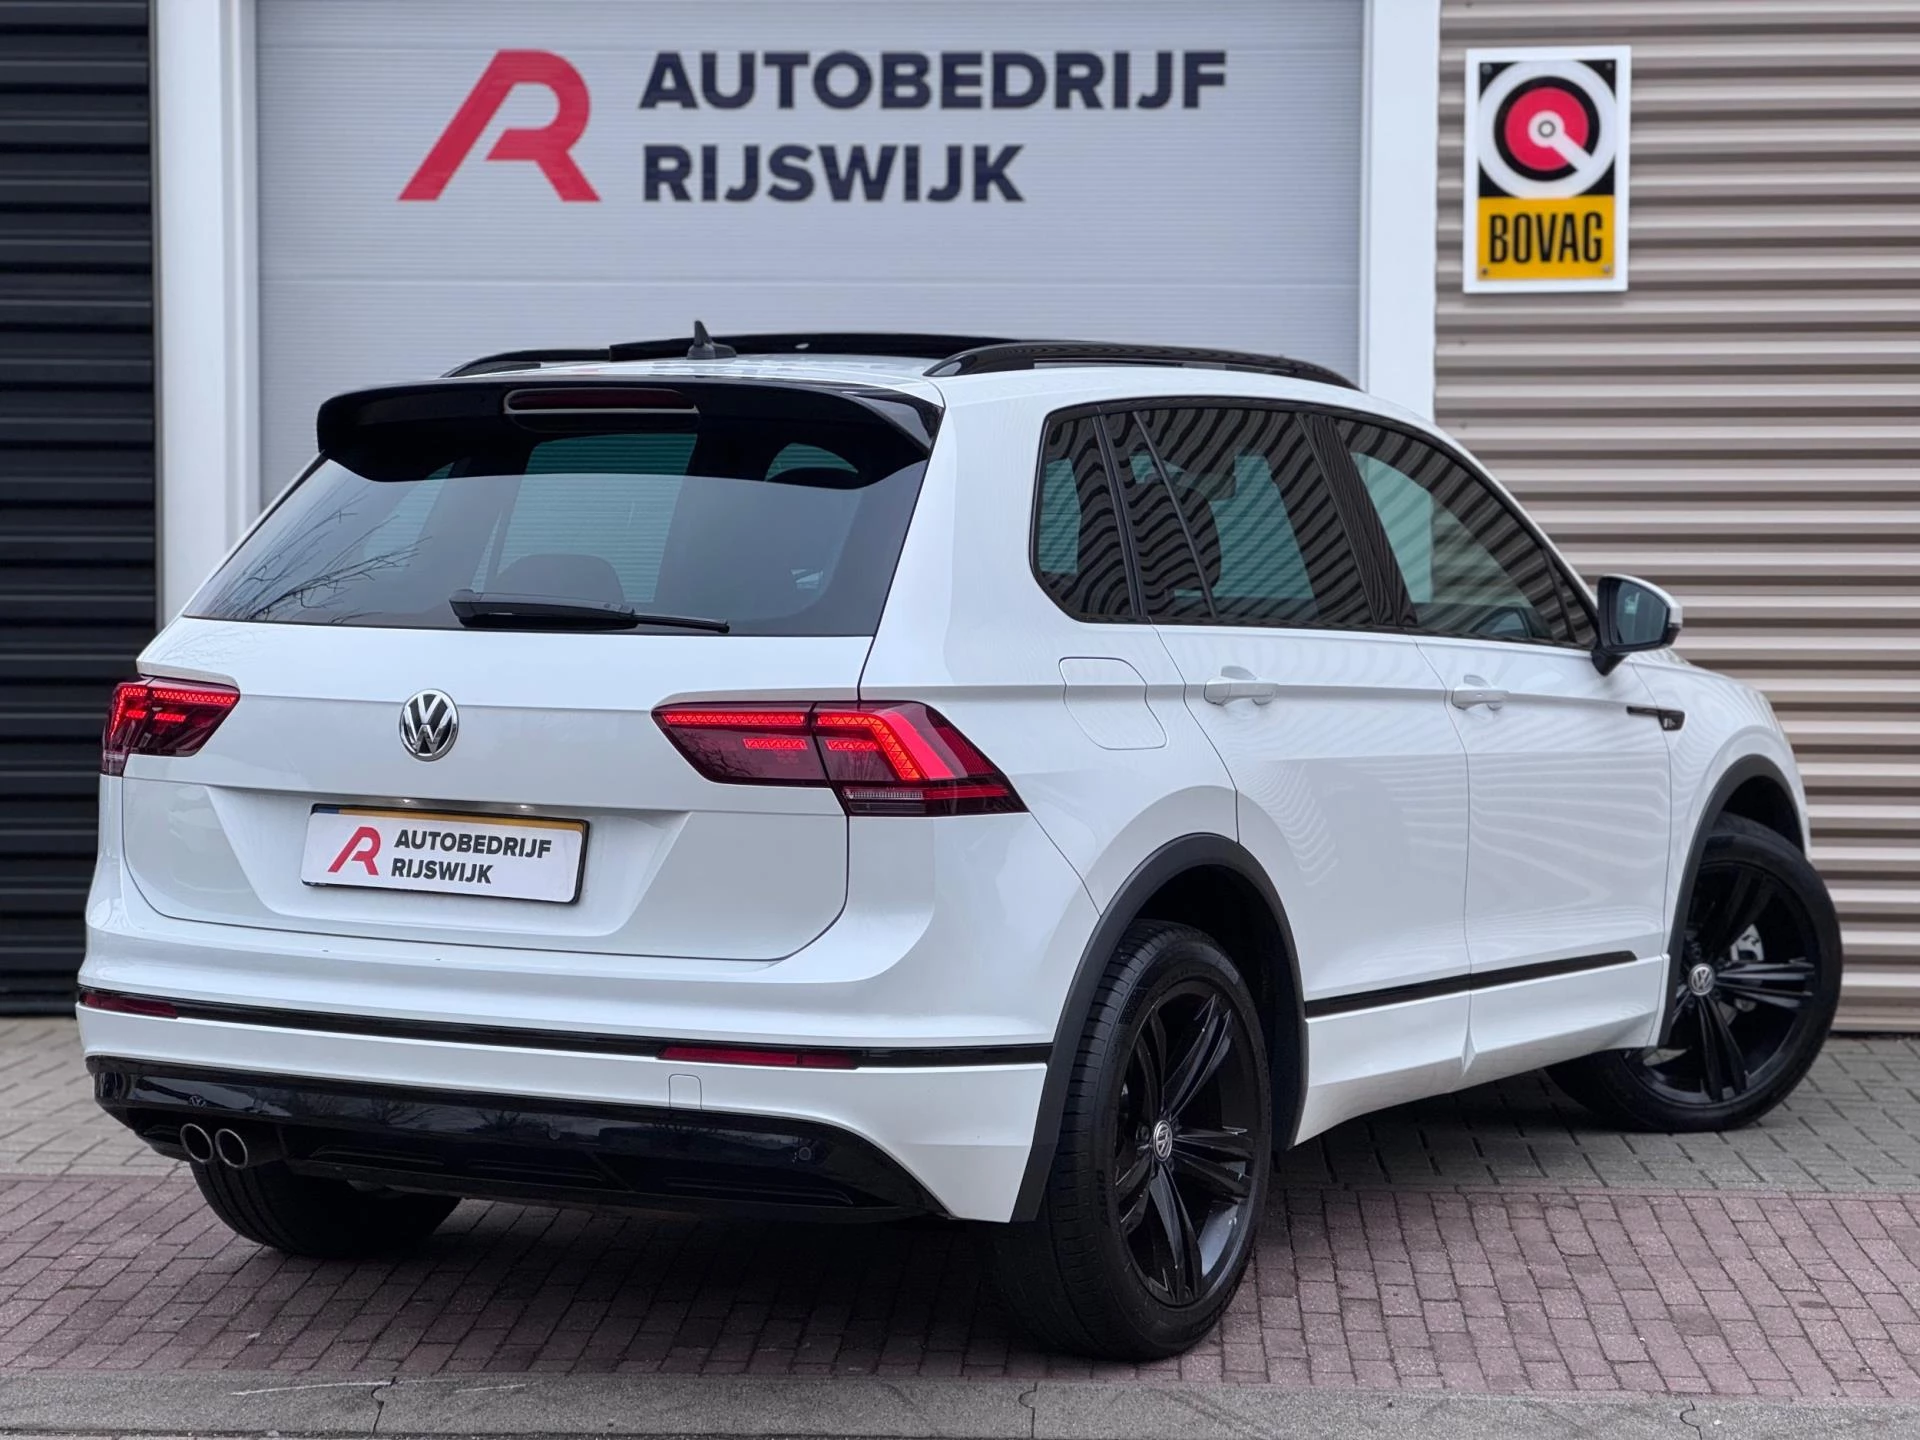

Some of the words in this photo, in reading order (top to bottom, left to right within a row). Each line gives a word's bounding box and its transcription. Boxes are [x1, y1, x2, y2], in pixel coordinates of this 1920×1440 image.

[639, 51, 1226, 109] AUTOBEDRIJF
[644, 145, 1025, 202] RIJSWIJK
[1489, 211, 1603, 264] BOVAG
[394, 829, 552, 859] AUTOBEDRIJF
[391, 858, 493, 884] RIJSWIJK
